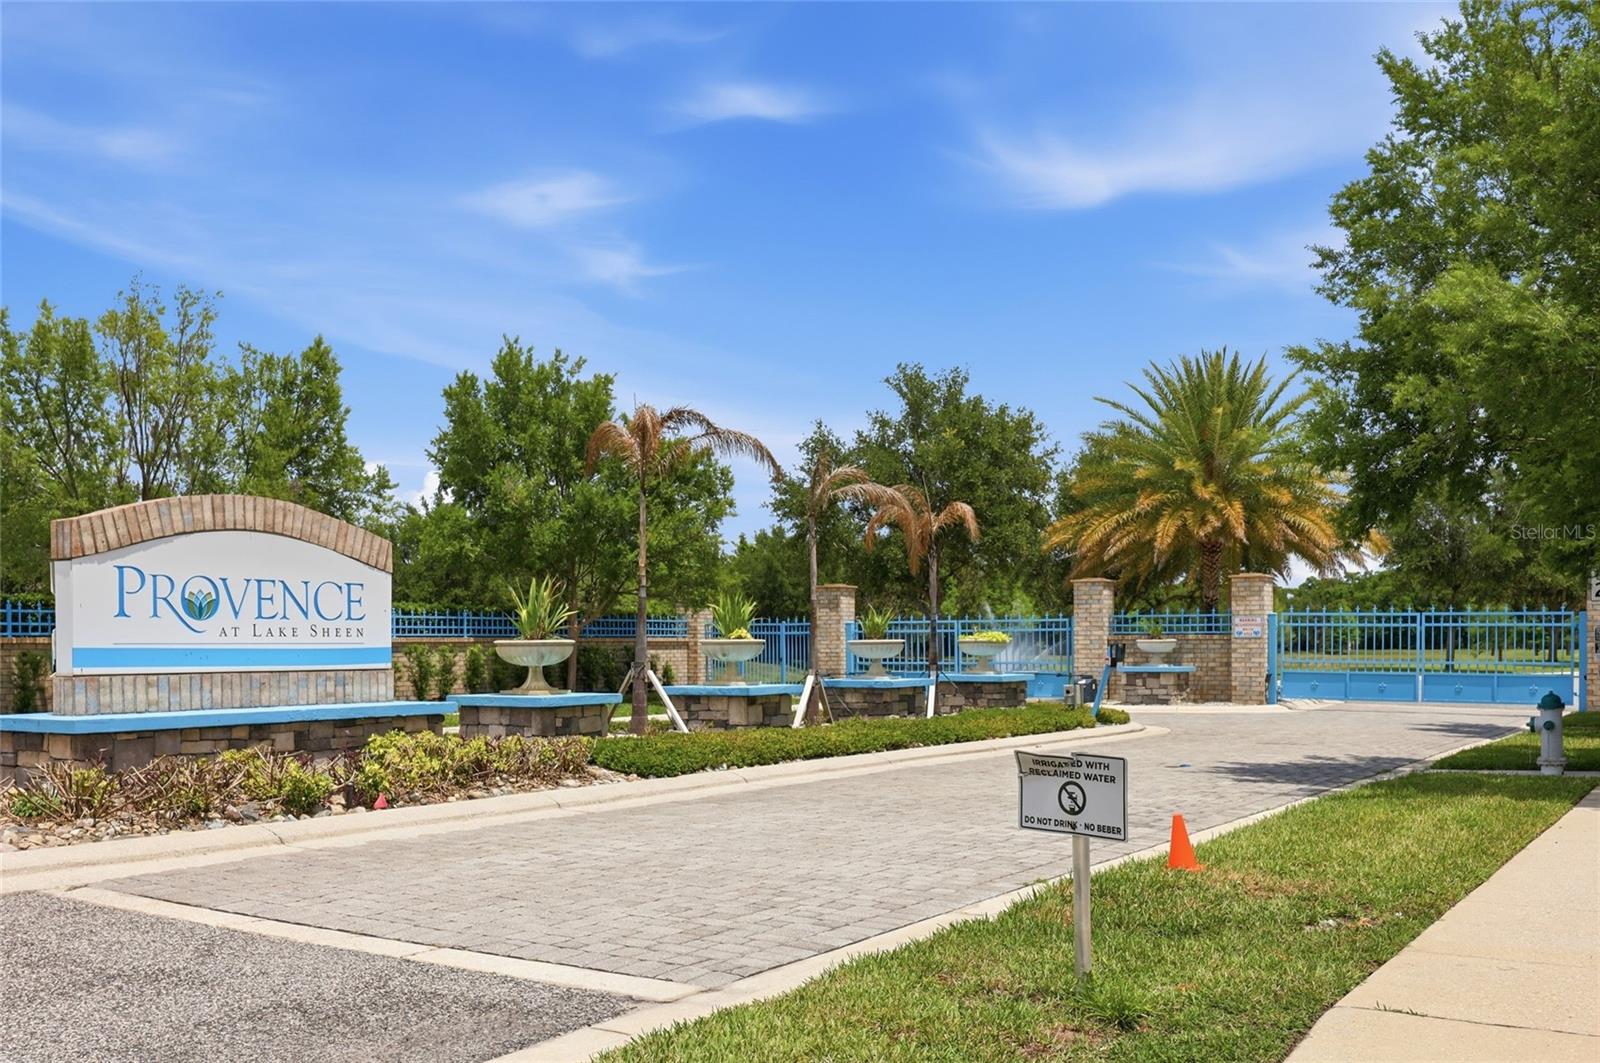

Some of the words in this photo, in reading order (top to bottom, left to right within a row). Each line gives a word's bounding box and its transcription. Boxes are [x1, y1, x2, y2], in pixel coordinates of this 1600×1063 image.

[113, 565, 367, 634] PROVENCE
[219, 626, 241, 638] AT
[252, 623, 300, 638] LAKE
[310, 624, 365, 638] SHEEN
[1085, 760, 1110, 771] WITH
[1028, 767, 1081, 779] RECLAIMED
[1083, 772, 1116, 784] WATER
[1024, 815, 1035, 824] DO
[1036, 817, 1052, 826] NOT
[1053, 818, 1078, 831] DRINK
[1085, 822, 1096, 832] NO
[1097, 825, 1122, 835] BEBER
